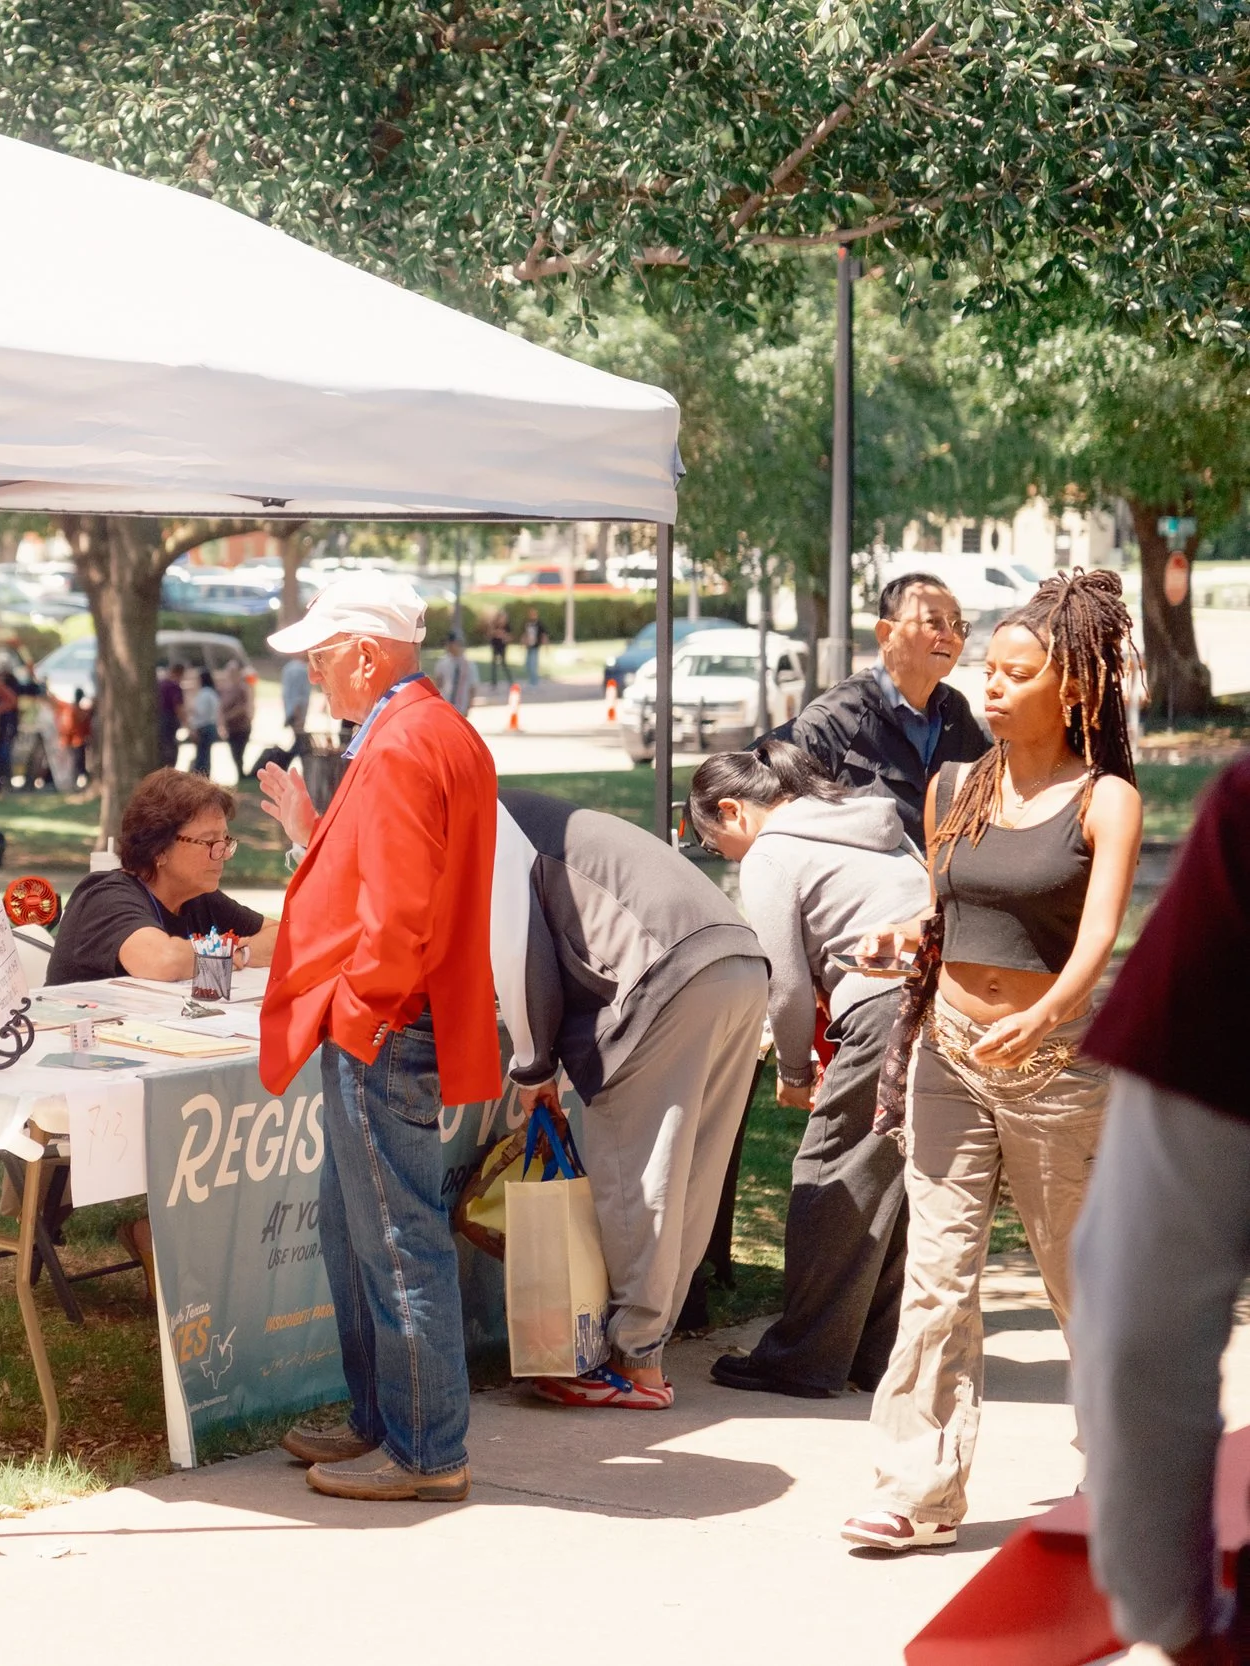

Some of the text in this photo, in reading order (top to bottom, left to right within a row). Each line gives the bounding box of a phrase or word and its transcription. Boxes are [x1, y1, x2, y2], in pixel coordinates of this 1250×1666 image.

[166, 1092, 324, 1208] REGIS
[261, 1200, 293, 1244] AT
[295, 1200, 320, 1233] YO
[268, 1247, 290, 1270] USE
[290, 1242, 317, 1264] YOUR
[185, 1302, 211, 1322] Texas
